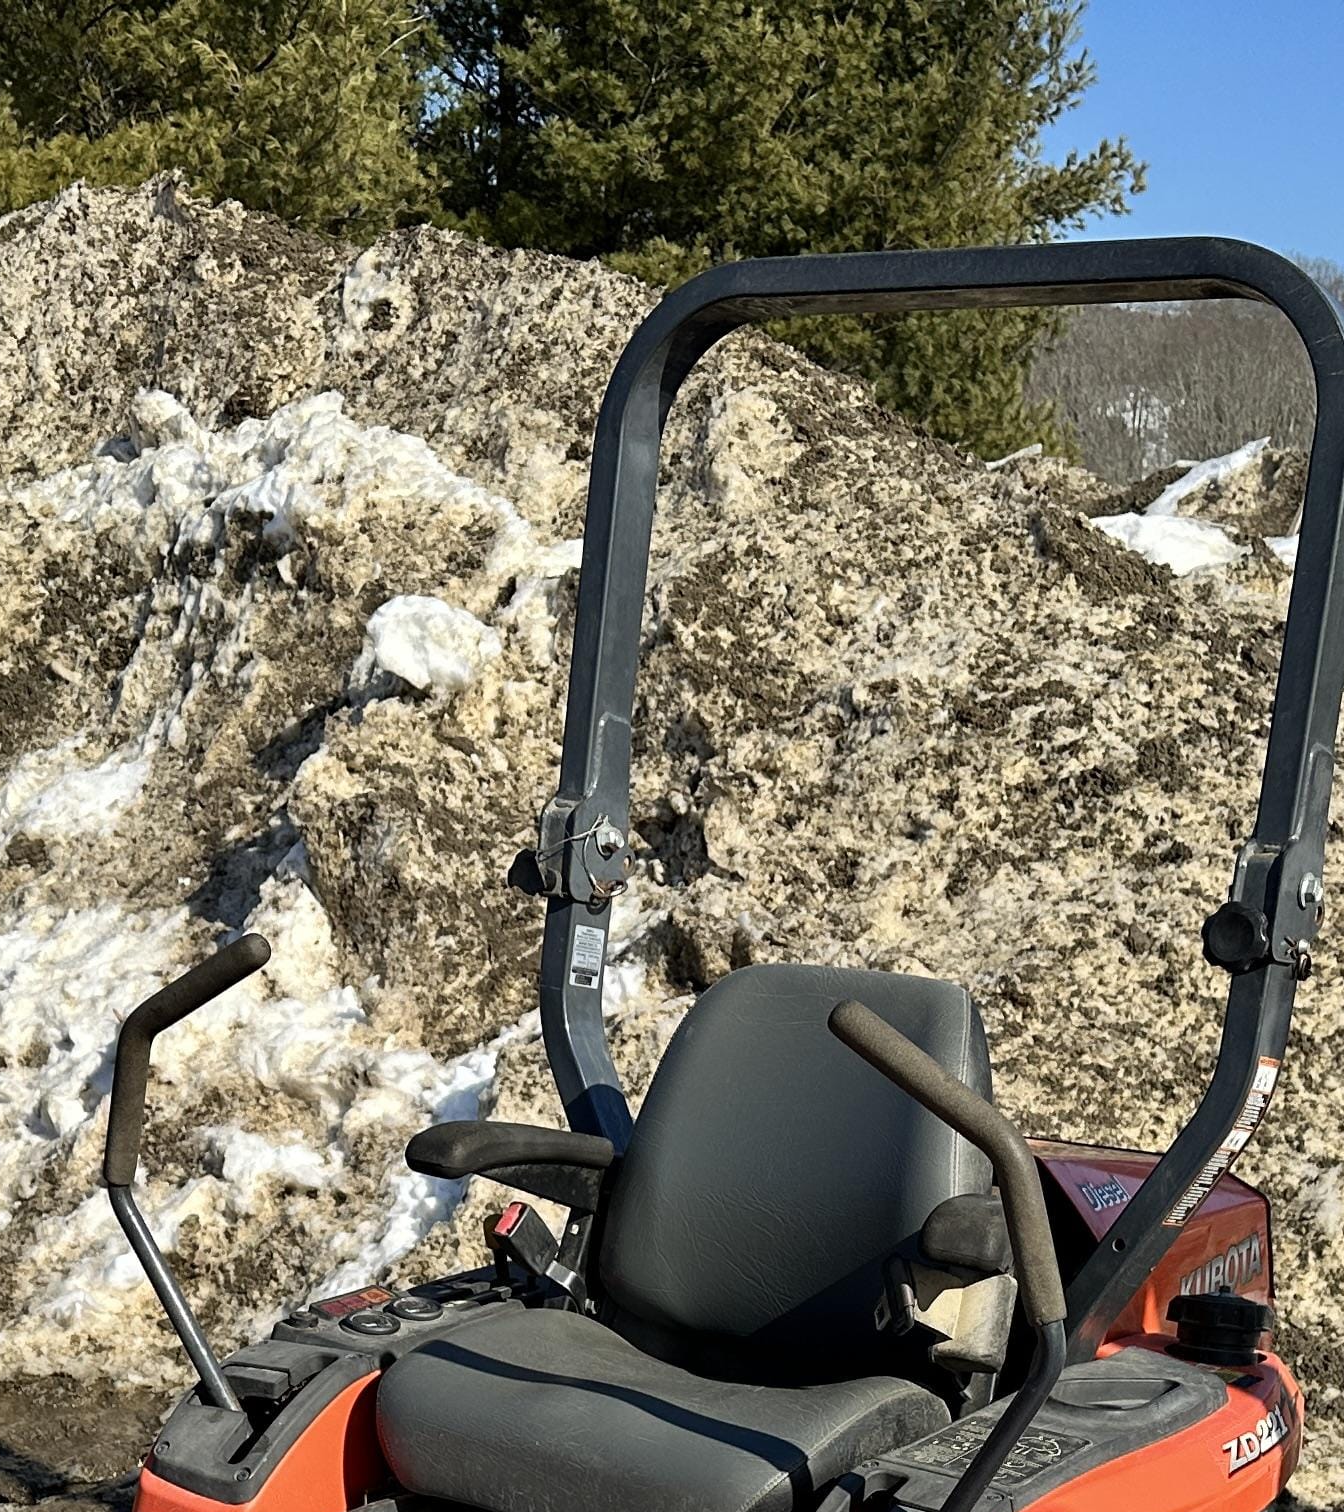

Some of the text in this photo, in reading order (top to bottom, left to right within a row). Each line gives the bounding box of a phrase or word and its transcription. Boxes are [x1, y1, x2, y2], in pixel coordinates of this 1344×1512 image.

[1080, 1175, 1132, 1211] Diesel
[1180, 1232, 1262, 1296] KUBOTA
[1222, 1403, 1288, 1474] ZD221
